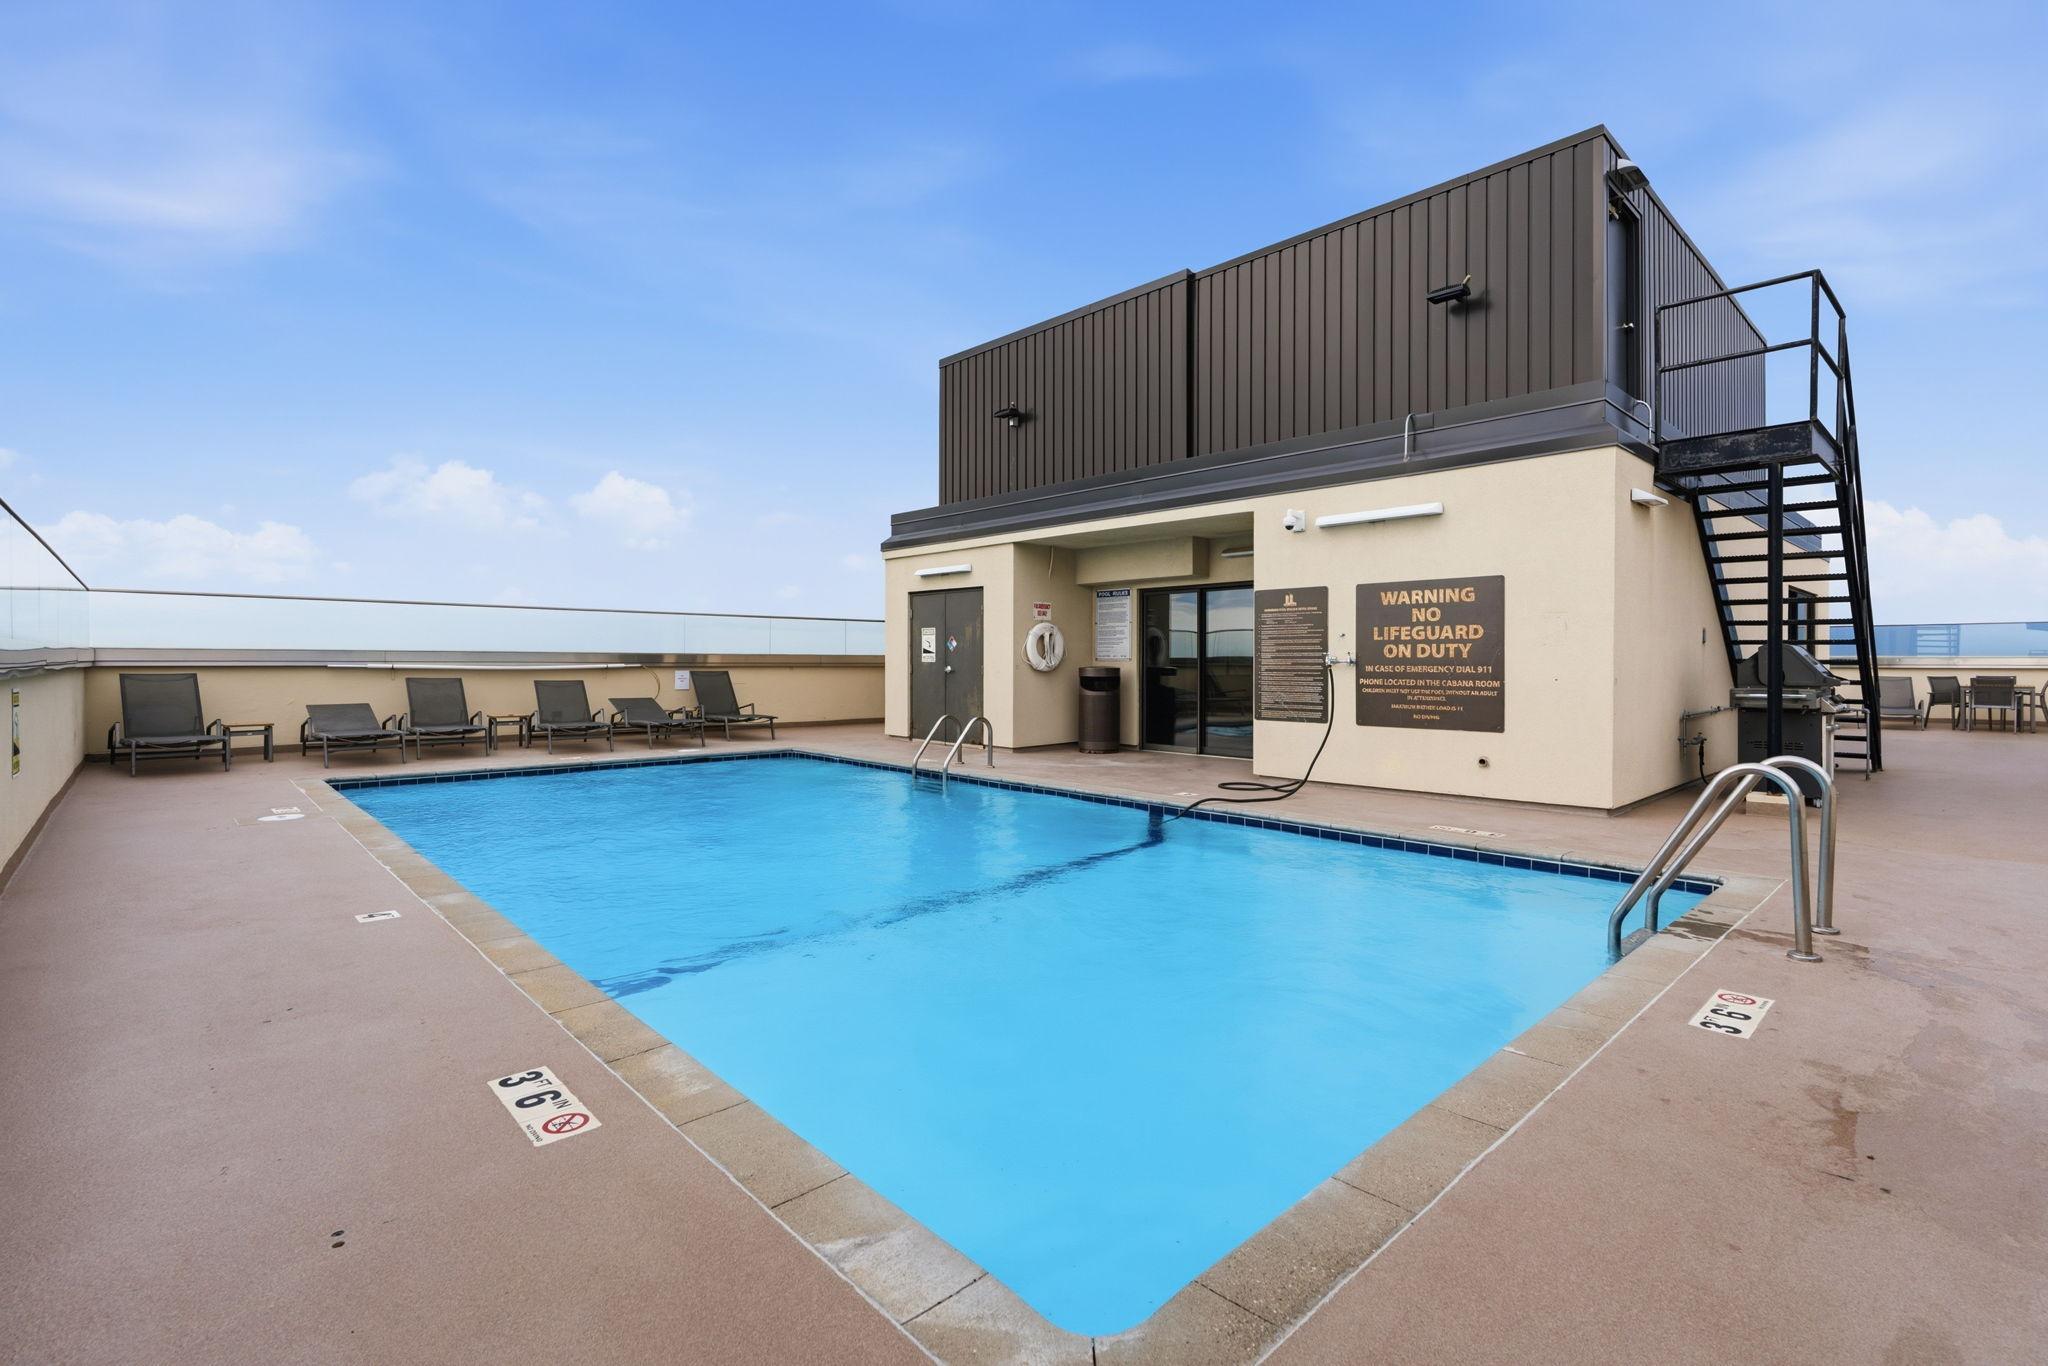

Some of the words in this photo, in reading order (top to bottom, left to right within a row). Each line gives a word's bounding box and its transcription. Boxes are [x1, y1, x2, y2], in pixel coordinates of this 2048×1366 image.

[1380, 587, 1476, 606] WARNING
[1411, 606, 1441, 623] NO
[1373, 624, 1485, 641] LIFEGUARD
[1383, 643, 1412, 658] ON
[1416, 643, 1472, 658] DUTY
[1375, 665, 1394, 673] CASE
[1395, 665, 1405, 673] OF
[1406, 665, 1455, 674] EMERGENCY
[1456, 665, 1476, 674] DIAL
[1477, 665, 1492, 674] 911
[1359, 678, 1383, 686] PHONE
[1384, 678, 1416, 686] LOCATED
[1426, 679, 1440, 687] THE
[1475, 680, 1501, 688] ROOM
[1710, 1008, 1752, 1021] 6
[1699, 1021, 1742, 1034] 3
[498, 1070, 544, 1088] 3
[515, 1089, 562, 1108] 6
[552, 1098, 572, 1109] IN
